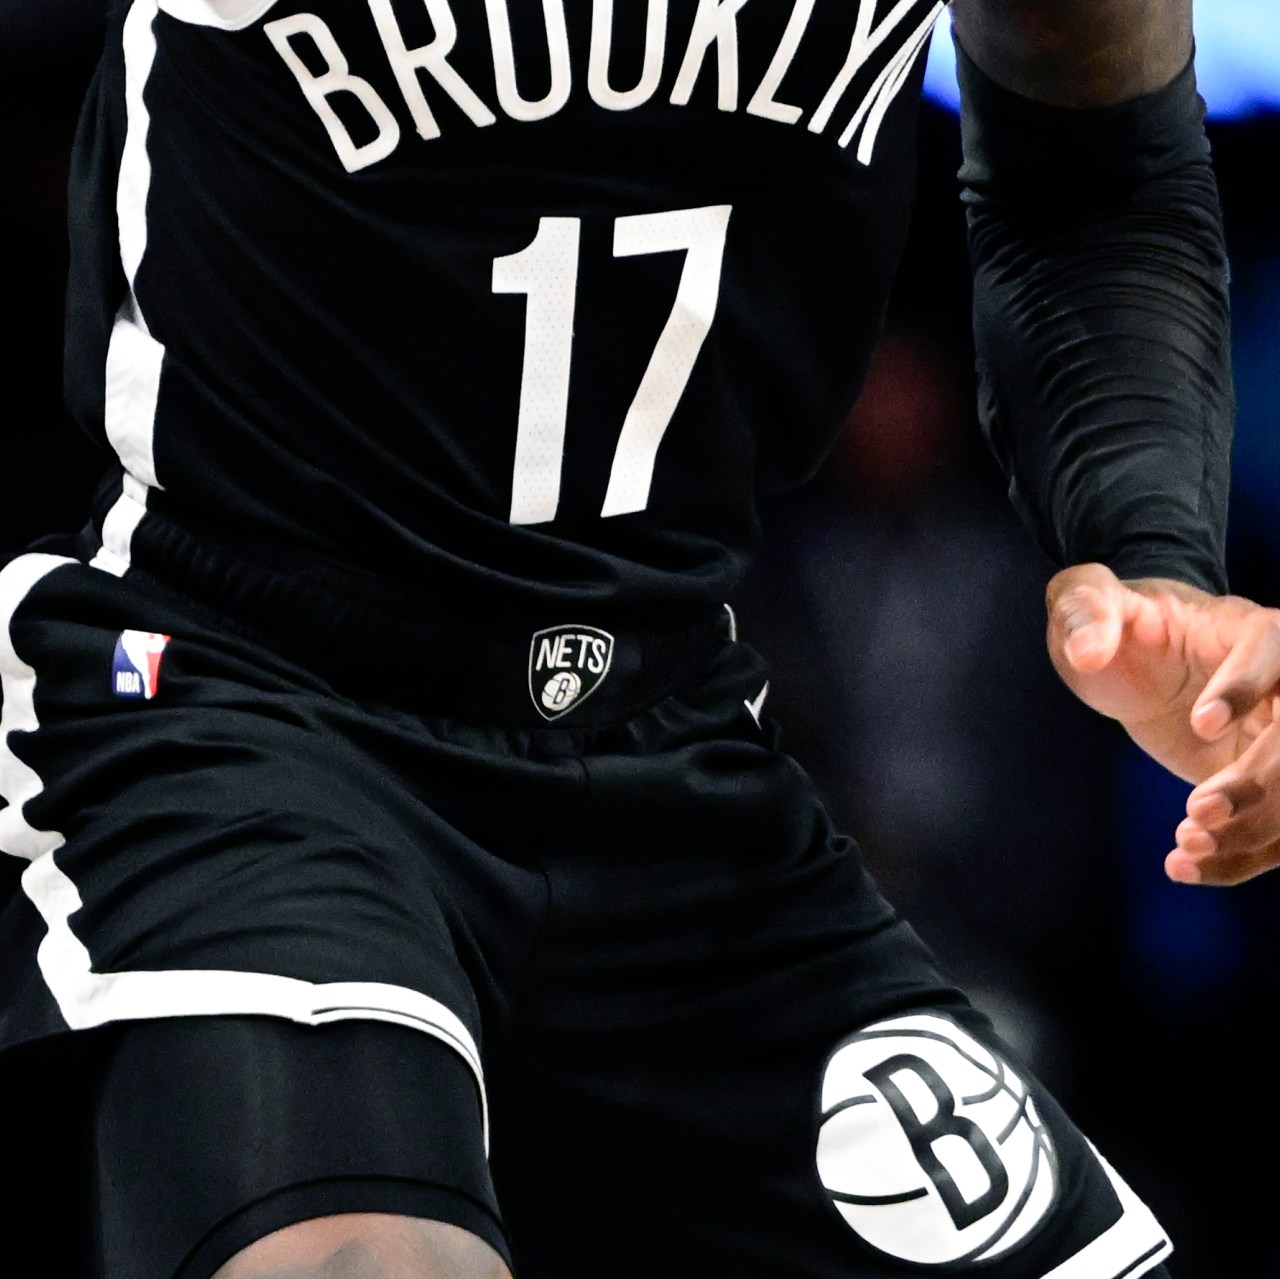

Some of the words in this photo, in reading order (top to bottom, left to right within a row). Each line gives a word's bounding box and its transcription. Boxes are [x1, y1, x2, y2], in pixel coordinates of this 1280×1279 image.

[491, 204, 733, 525] 17
[116, 671, 141, 694] NBA
[535, 634, 606, 674] NETS
[862, 1053, 1009, 1231] B
